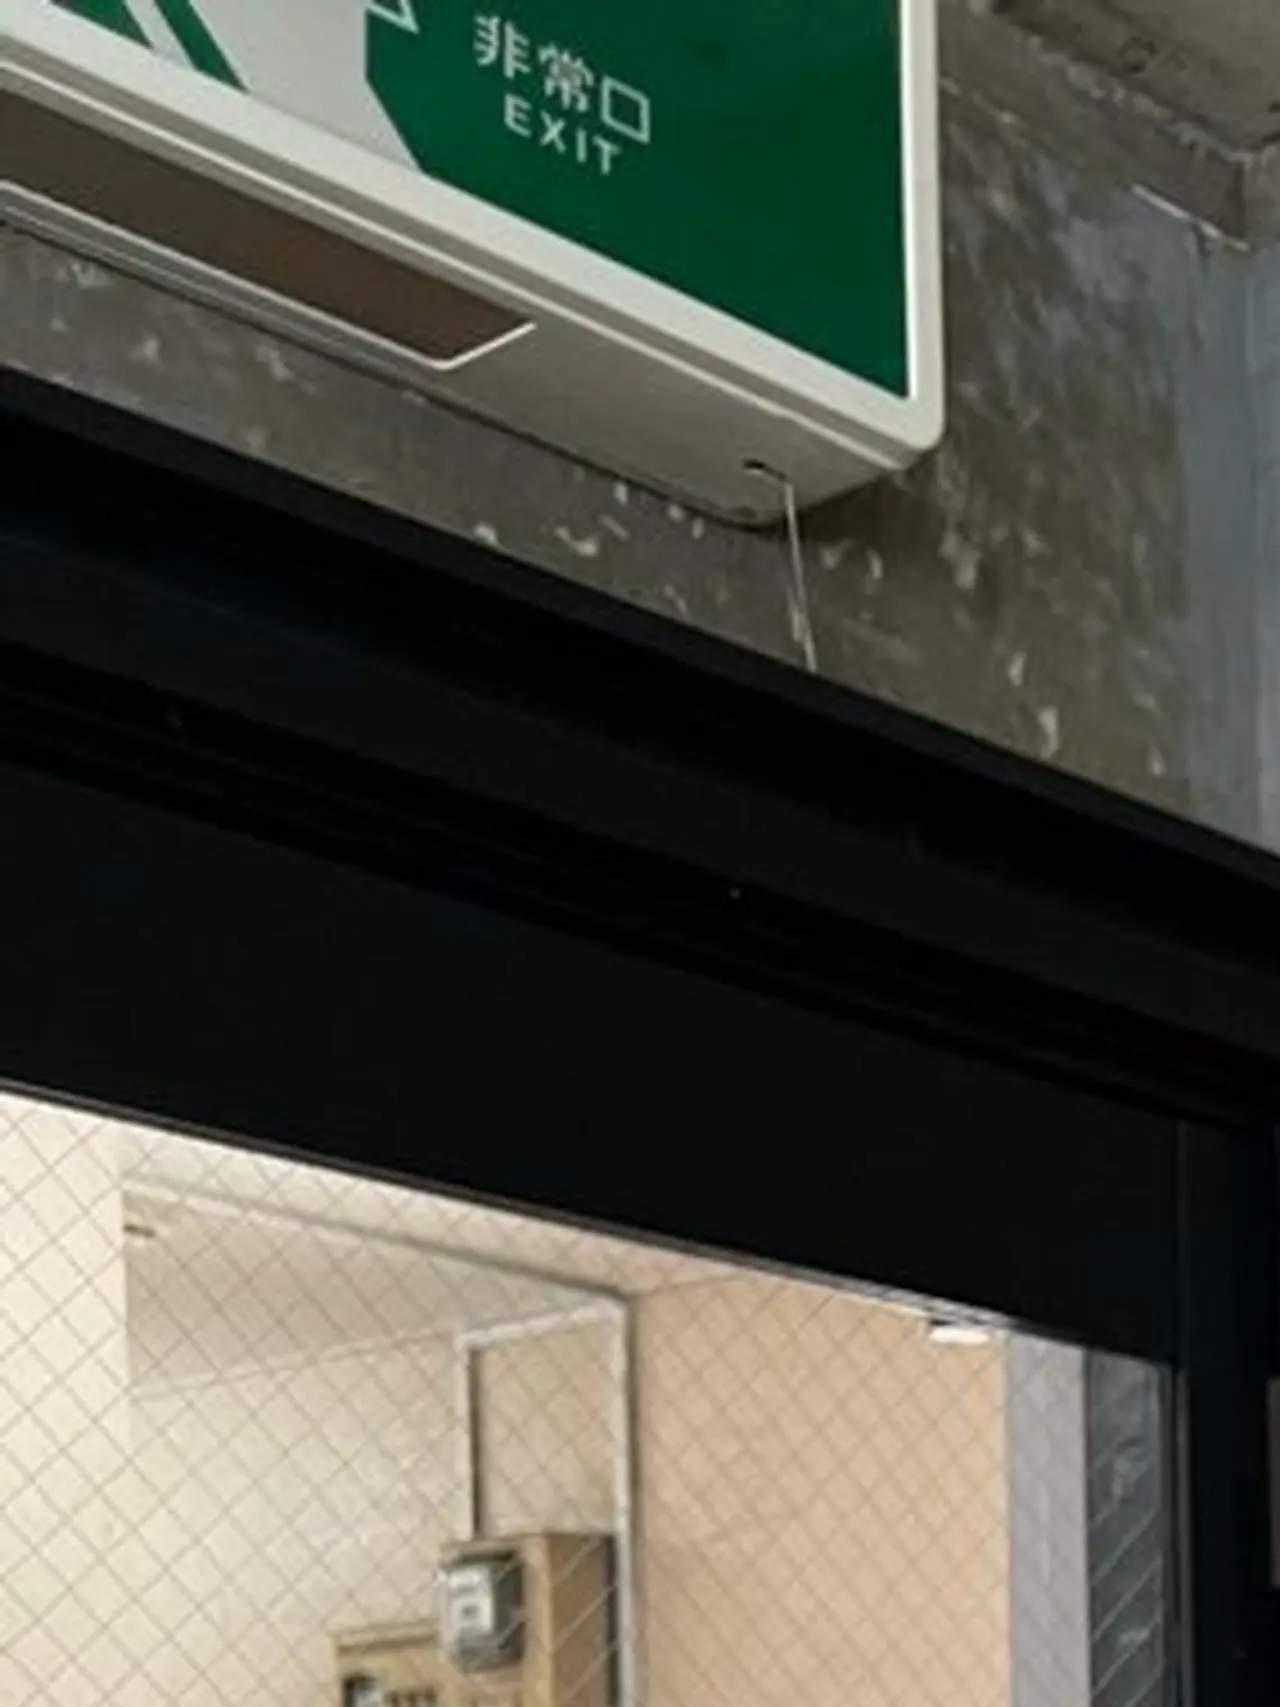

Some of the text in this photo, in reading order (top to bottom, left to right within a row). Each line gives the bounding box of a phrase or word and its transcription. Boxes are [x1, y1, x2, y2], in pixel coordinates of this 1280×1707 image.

[473, 14, 650, 145] 非常口
[504, 93, 621, 175] EXIT
